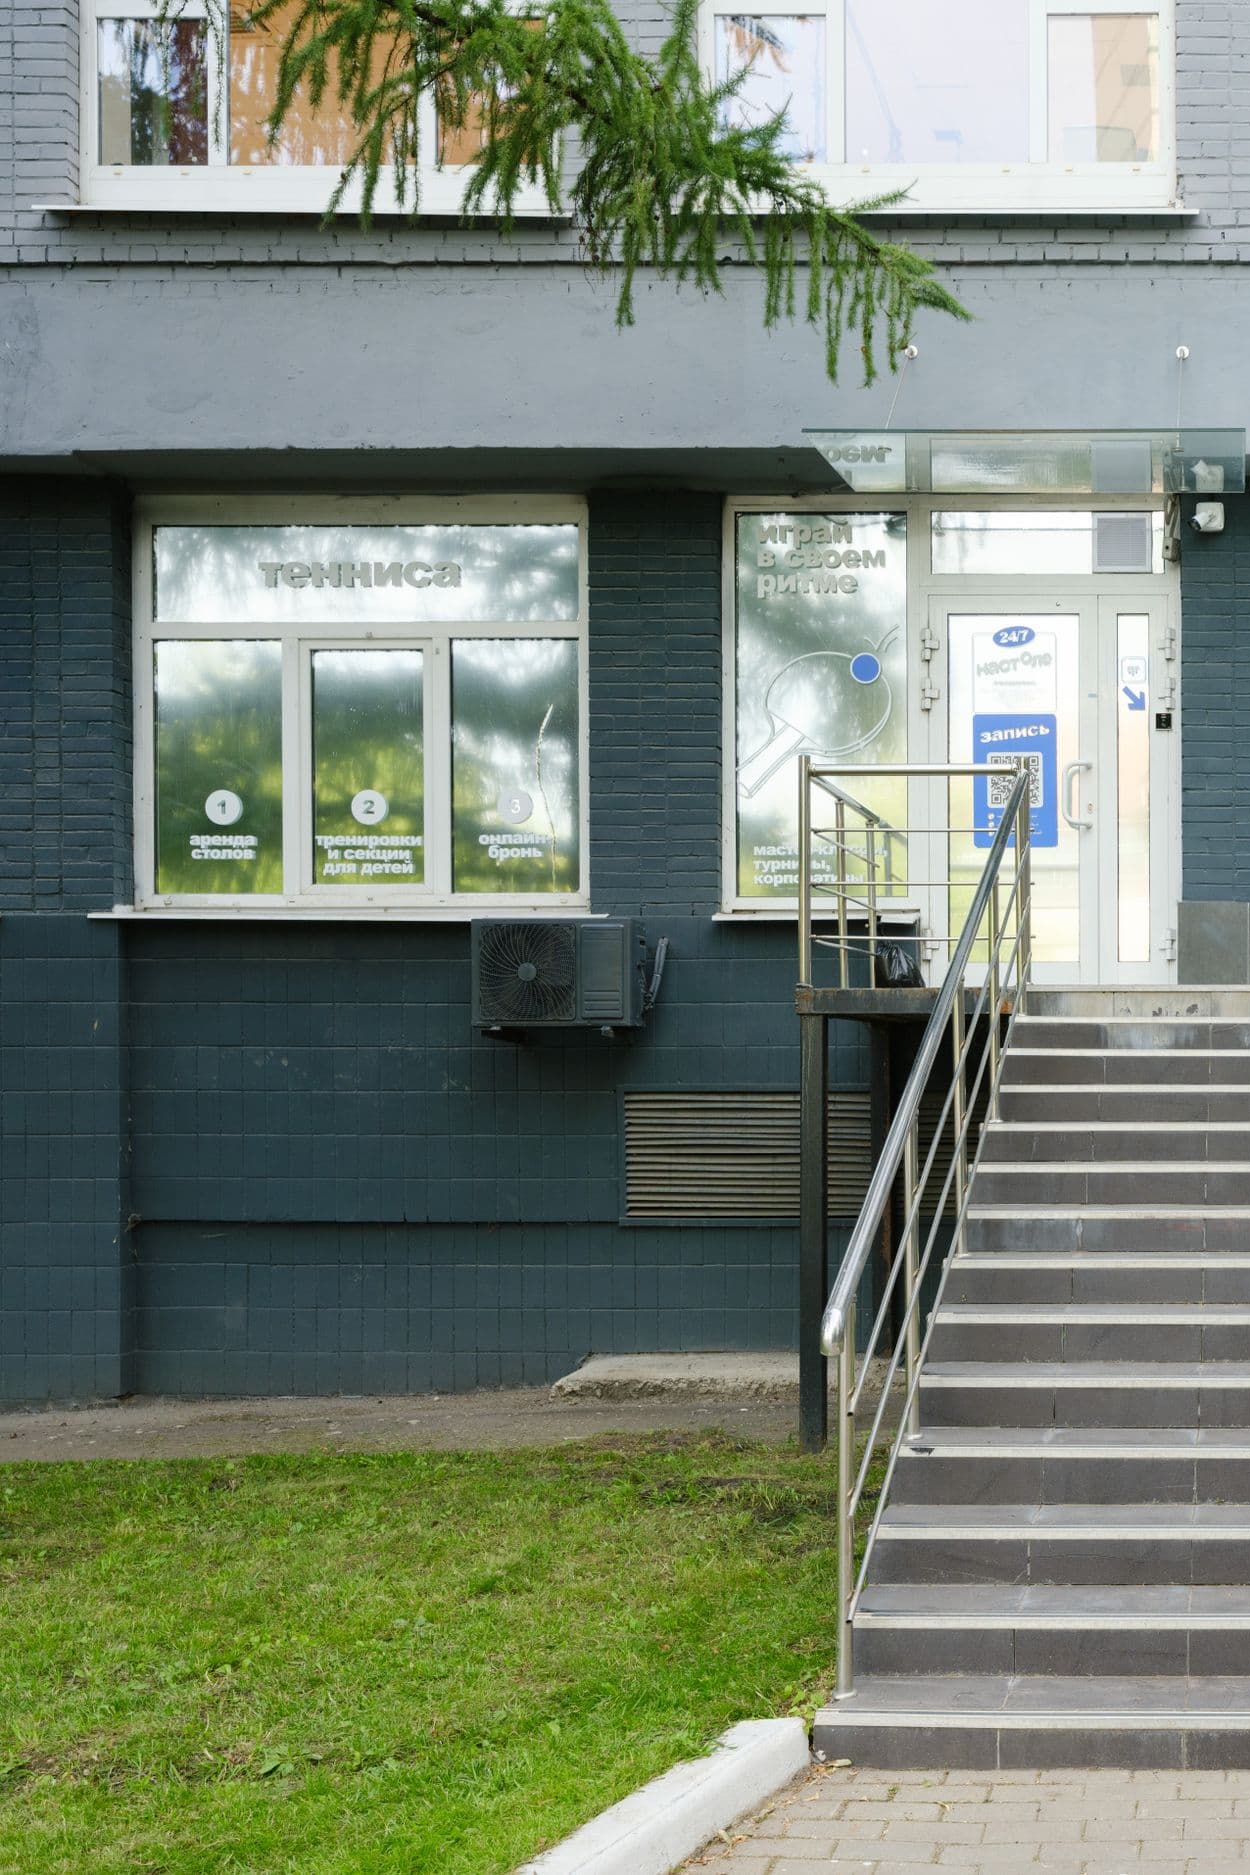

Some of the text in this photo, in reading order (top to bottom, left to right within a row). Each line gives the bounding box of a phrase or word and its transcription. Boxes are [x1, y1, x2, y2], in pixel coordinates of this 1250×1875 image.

[759, 520, 853, 549] играй
[757, 549, 886, 569] в своем
[257, 560, 462, 588] тенниса
[757, 574, 858, 600] ритме
[999, 629, 1030, 644] 24/7
[979, 724, 1051, 744] запись
[217, 799, 226, 815] 1
[363, 799, 375, 815] 2
[511, 799, 521, 814] 3
[190, 834, 258, 849] аренда
[315, 834, 423, 849] тренировки
[191, 848, 256, 860] столов
[328, 849, 412, 863] и секции
[488, 845, 544, 862] бронь
[323, 858, 416, 876] для детей
